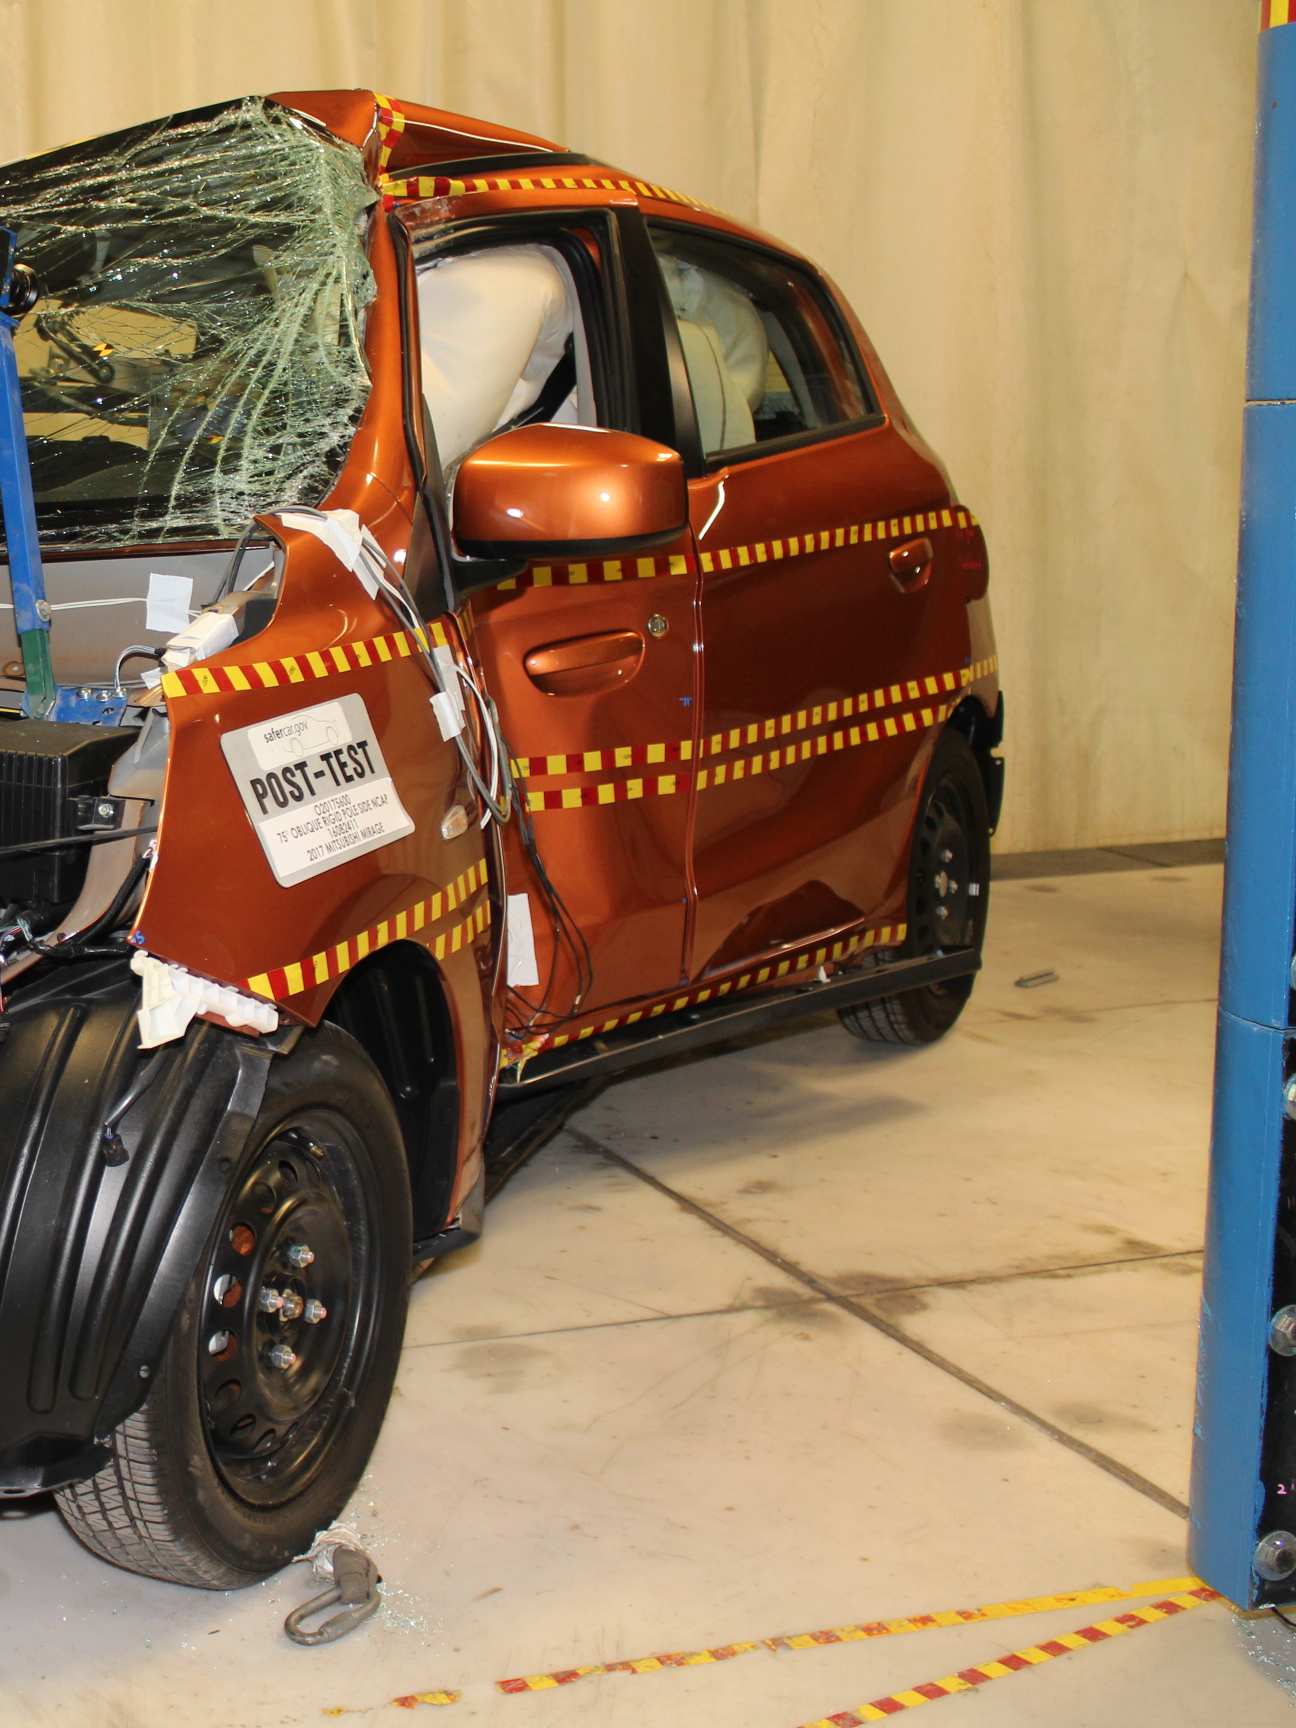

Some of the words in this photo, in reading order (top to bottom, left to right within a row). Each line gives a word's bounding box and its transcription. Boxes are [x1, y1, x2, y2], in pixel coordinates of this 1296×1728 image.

[264, 721, 309, 743] safercar.gov
[250, 740, 376, 815] POST-TEST
[290, 818, 323, 839] OBLIQUE
[321, 811, 343, 828] RIGID
[341, 804, 359, 820] POLE
[357, 799, 372, 814] SIDE
[371, 793, 389, 809] NCAP
[327, 818, 359, 839] 16082411
[307, 845, 325, 861] 2017
[324, 831, 362, 855] MITSUBISHI
[360, 822, 385, 840] MIRAGE
[1277, 1483, 1288, 1495] 2
